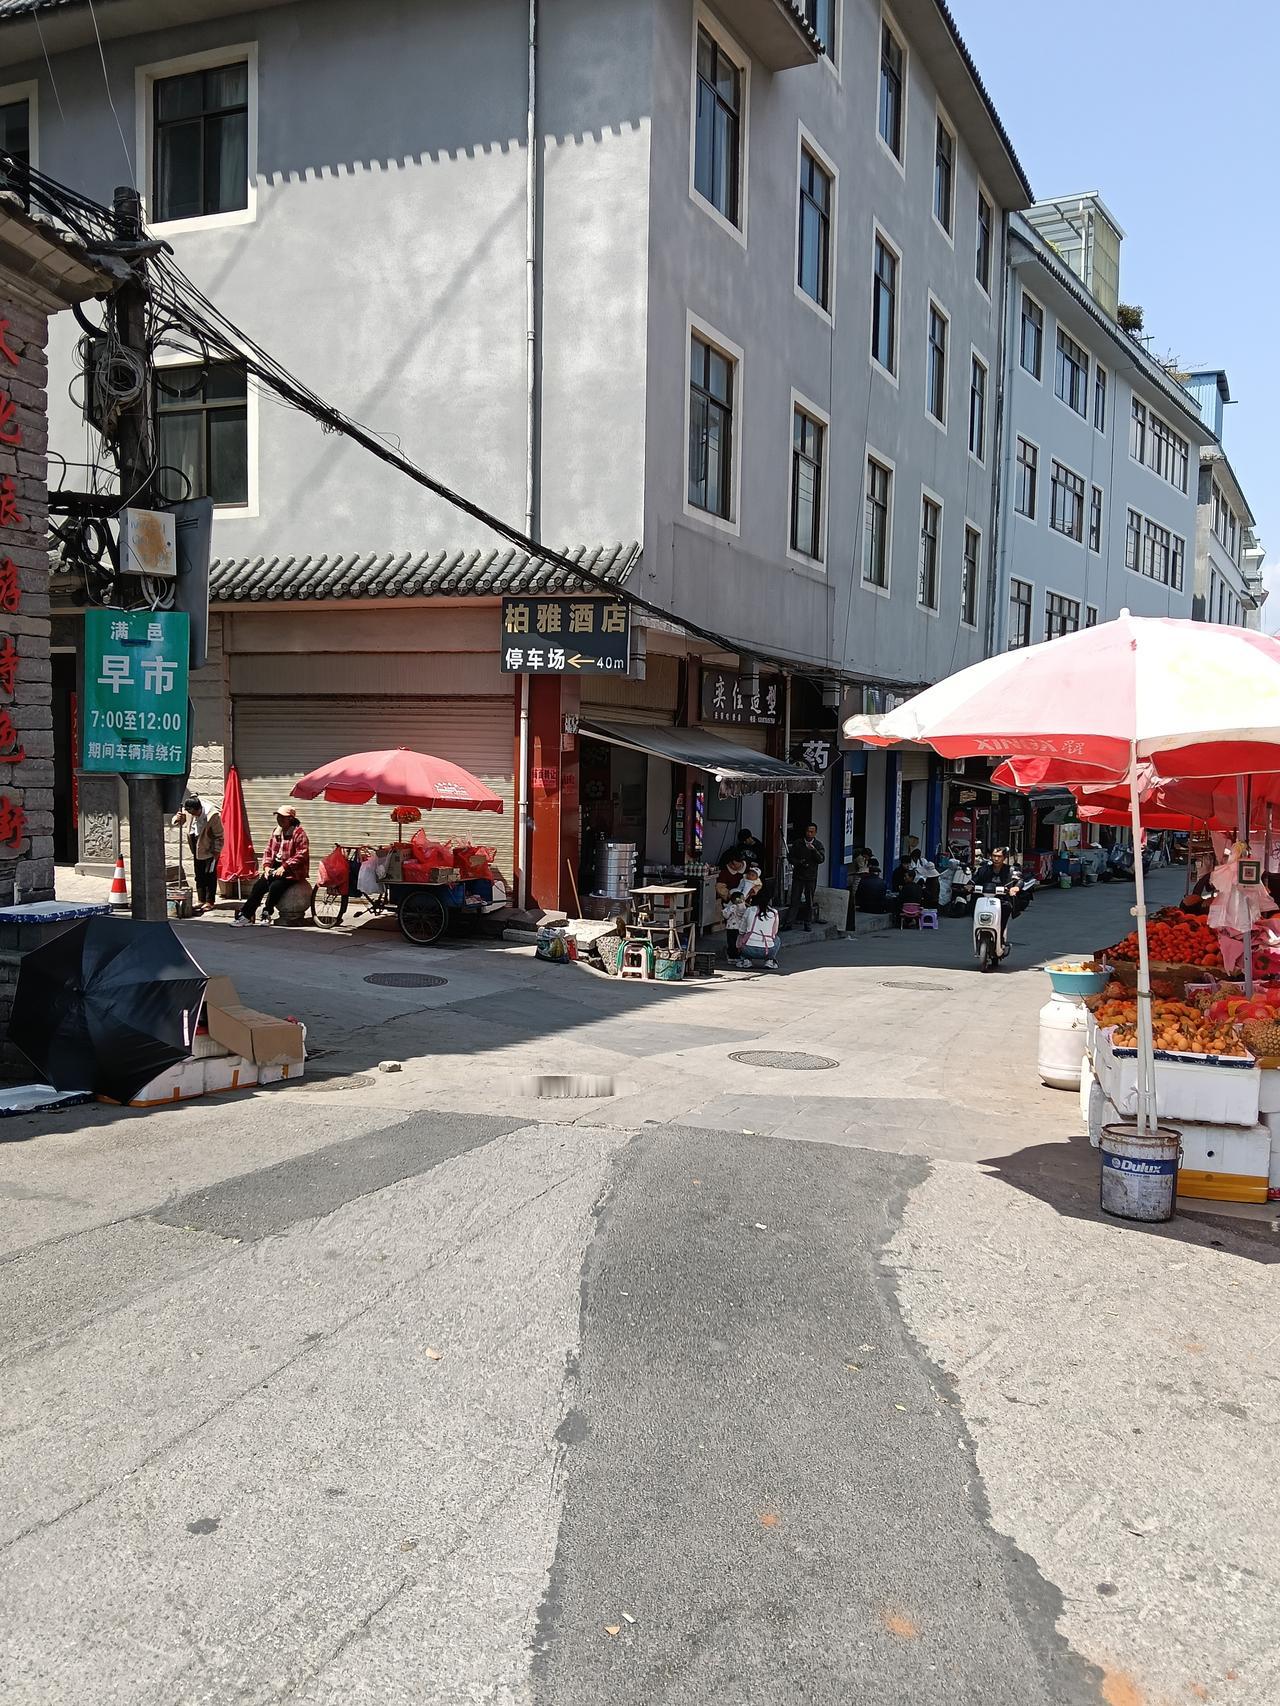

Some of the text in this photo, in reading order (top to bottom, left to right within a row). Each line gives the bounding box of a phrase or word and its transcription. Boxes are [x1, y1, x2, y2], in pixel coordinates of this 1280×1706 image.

[505, 603, 627, 633] 柏雅酒店
[110, 621, 165, 642] 满邑
[505, 648, 624, 670] 停车场 40m
[97, 655, 178, 695] 早市
[91, 710, 181, 731] 7:00至12:00
[88, 741, 182, 762] 期间车辆请绕行
[802, 740, 830, 769] 药
[1121, 1159, 1162, 1174] Dulux
